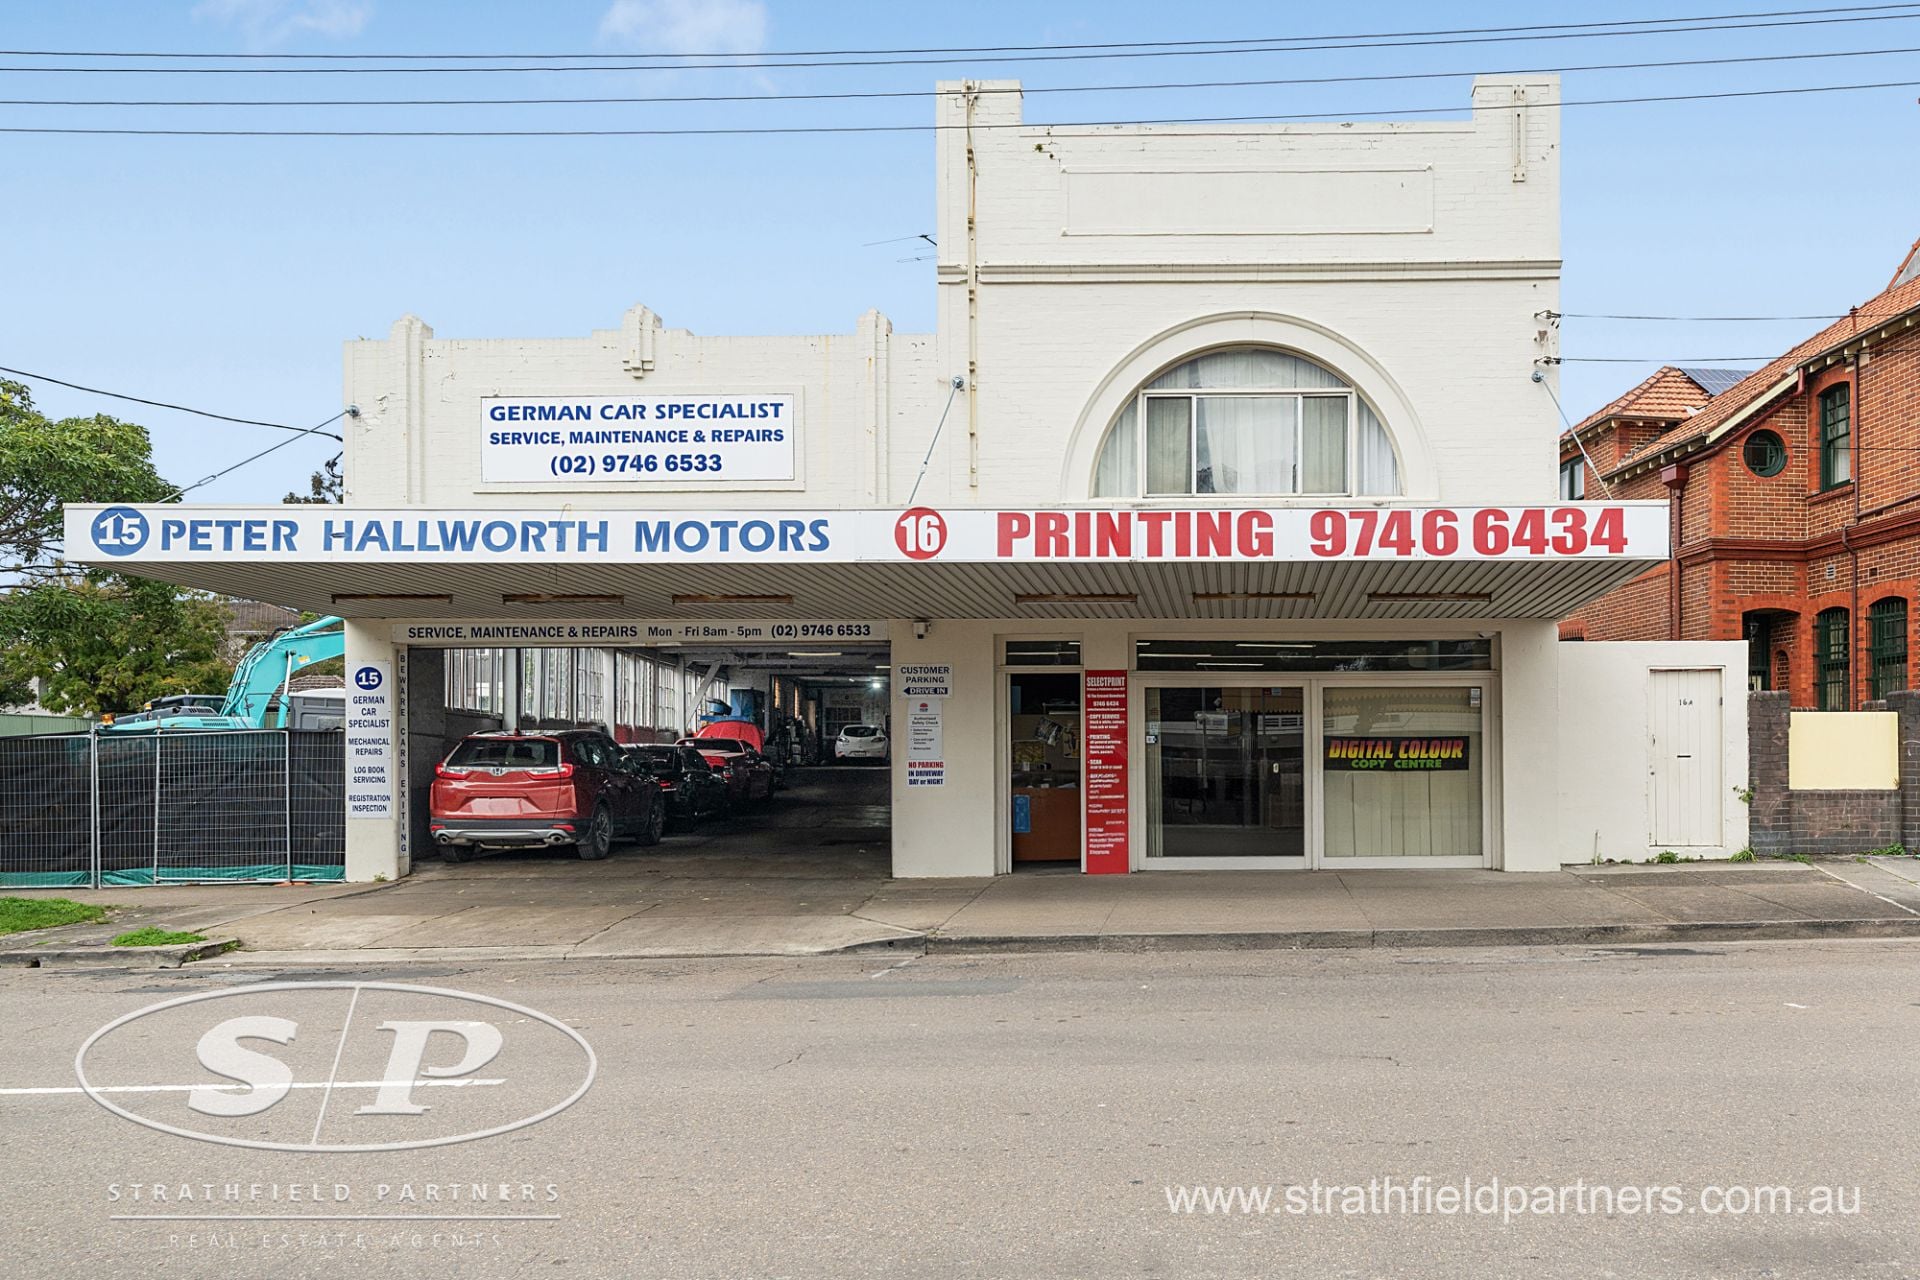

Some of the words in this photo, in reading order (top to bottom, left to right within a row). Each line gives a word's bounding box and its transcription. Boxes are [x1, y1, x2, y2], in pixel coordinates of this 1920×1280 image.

[490, 405, 592, 421] GERMAN
[599, 404, 647, 420] CAR
[655, 402, 784, 419] SPECIALIST
[489, 431, 565, 447] SERVICE,
[569, 430, 688, 444] MAINTENANCE
[693, 430, 706, 443] &
[711, 429, 784, 442] REPAIRS
[550, 455, 596, 476] (02)
[602, 454, 658, 473] 9746
[664, 453, 722, 472] 6533
[99, 513, 142, 547] 15
[161, 519, 298, 552] PETER
[322, 518, 609, 553] HALLWORTH
[633, 518, 830, 553] MOTORS
[899, 516, 943, 550] 16
[999, 510, 1274, 557] PRINTING
[1309, 508, 1460, 557] 9746
[1472, 507, 1628, 555] 6434
[408, 627, 467, 640] SERVICE,
[470, 626, 565, 638] MAINTENANCE
[568, 626, 578, 638] &
[582, 626, 638, 638] REPAIRS
[647, 626, 672, 637] Mon
[685, 626, 700, 637] Fri
[702, 626, 728, 637] 8am
[737, 626, 762, 639] 5pm
[771, 624, 798, 639] (02)
[801, 624, 834, 636] 9746
[837, 624, 871, 636] 6533
[358, 672, 379, 686] 15
[1087, 677, 1125, 687] SELECTPRINT
[352, 695, 385, 705] GERMAN
[1679, 698, 1693, 706] 16A
[361, 707, 377, 716] CAR
[348, 719, 390, 728] SPECIALIST
[348, 737, 390, 746] MECHANICAL
[355, 747, 383, 756] REPAIRS
[1328, 739, 1394, 759] DIGITAL
[1398, 739, 1464, 759] COLOUR
[1351, 759, 1388, 769] COPY
[1393, 759, 1442, 769] CENTRE
[353, 766, 367, 774] LOG
[367, 766, 385, 774] BOOK
[352, 776, 386, 784] SERVICING
[348, 794, 391, 802] REGISTRATION
[352, 804, 387, 812] INSPECTION
